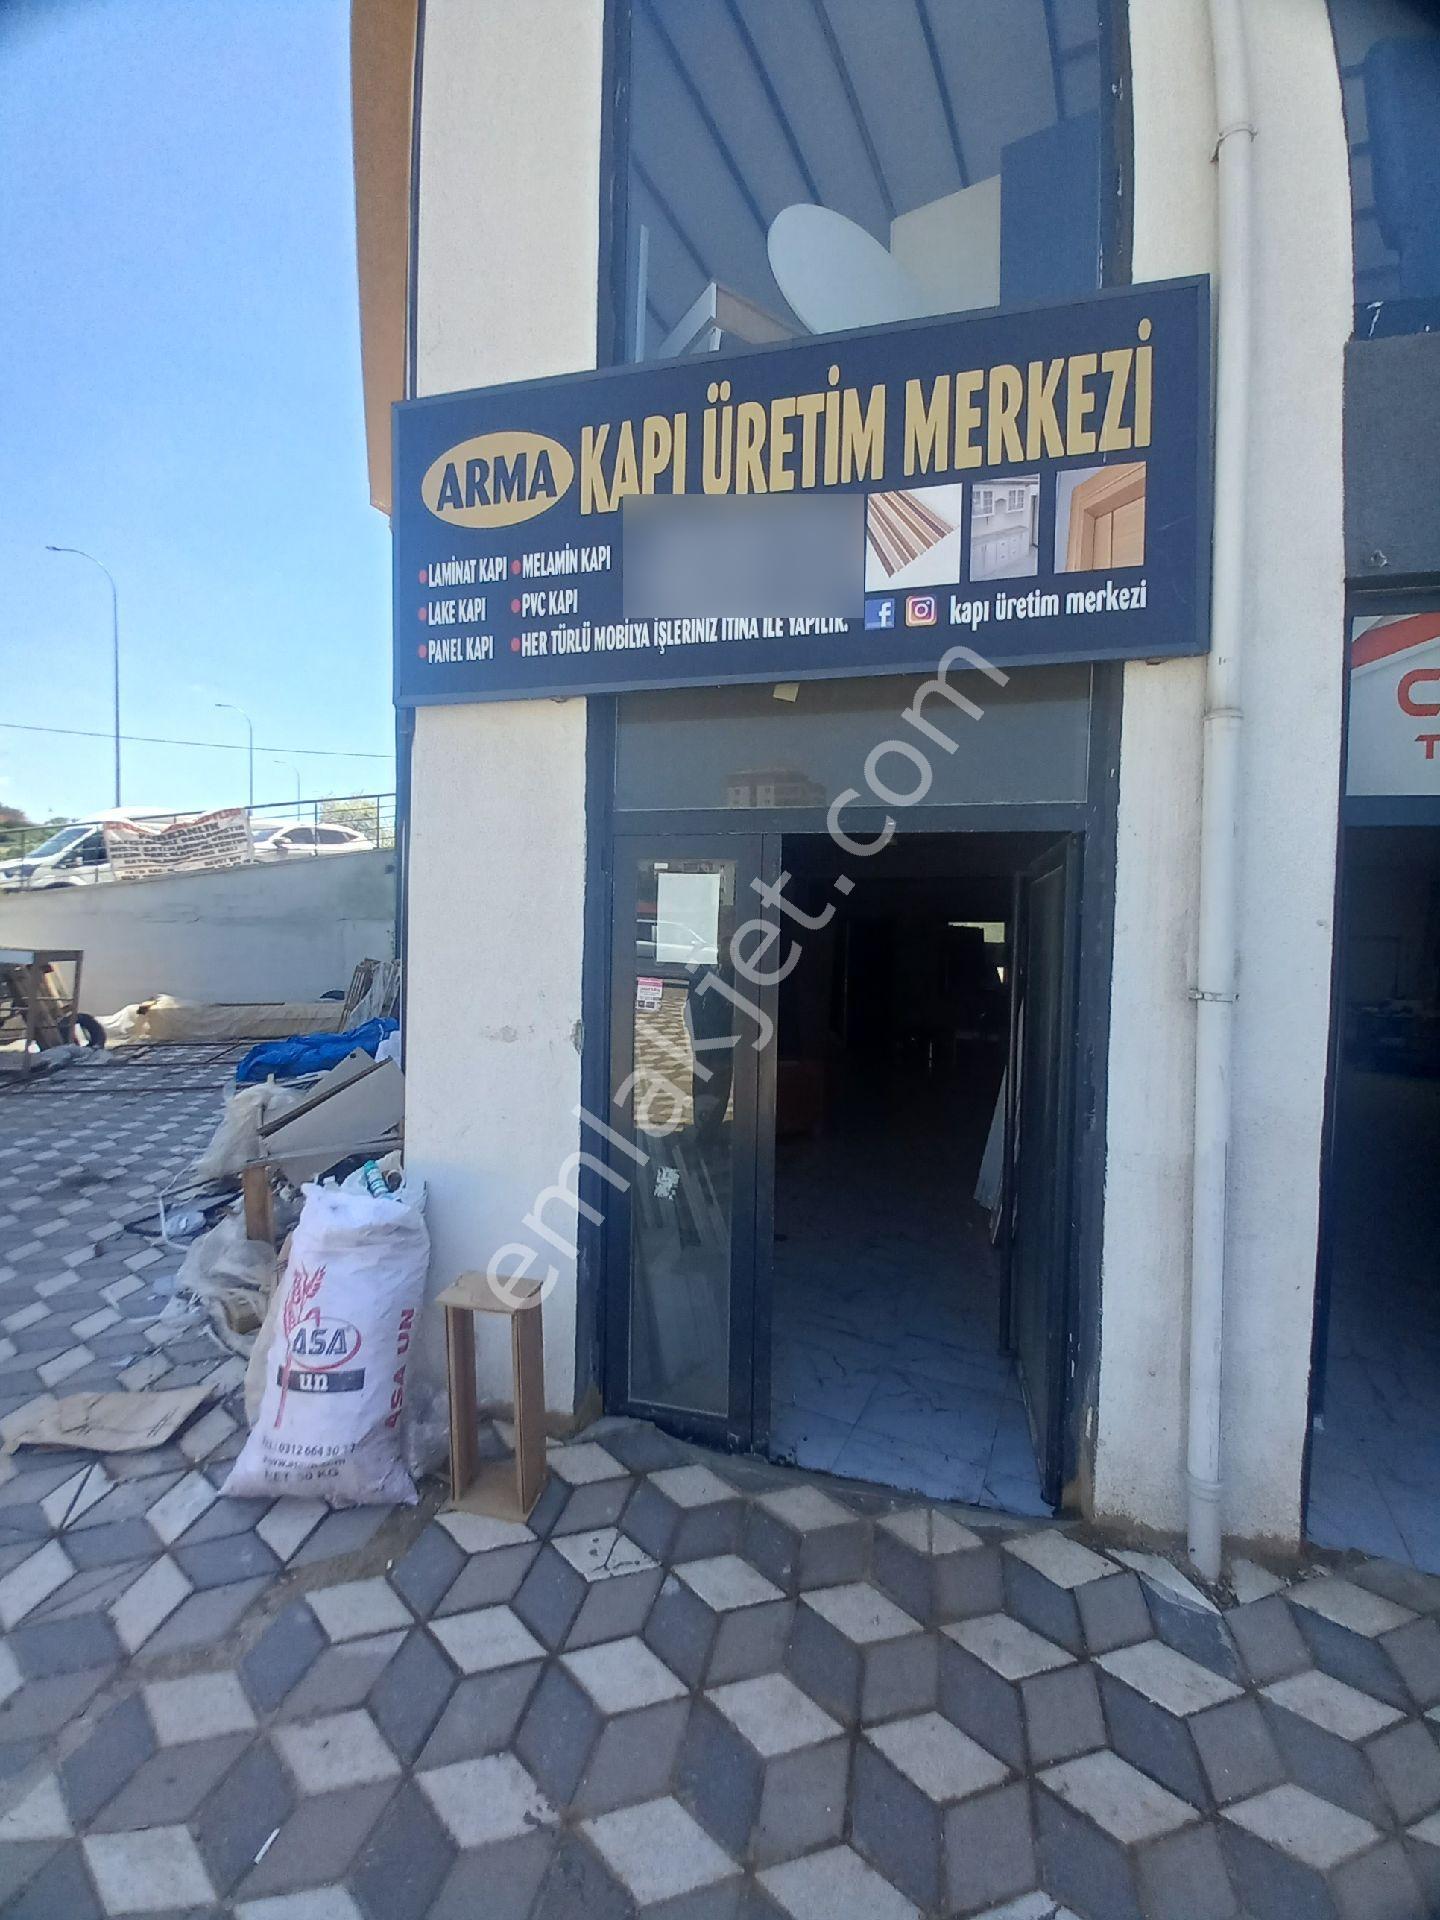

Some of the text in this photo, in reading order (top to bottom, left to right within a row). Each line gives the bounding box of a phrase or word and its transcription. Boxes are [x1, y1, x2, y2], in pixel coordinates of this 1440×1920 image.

[579, 318, 1153, 516] KAPI ÜRETİM MERKEZİ
[436, 450, 559, 512] ARMA
[428, 555, 508, 587] LAMİNAT KAPI
[522, 543, 611, 578] MELAMİN KAPI
[428, 597, 487, 626] LAKE KAPI
[521, 589, 578, 618] PVC KAPI
[949, 579, 1147, 631] kapı üretim merkezi
[428, 635, 494, 664] PANEL KAPI
[521, 630, 548, 657] HER
[551, 622, 591, 655] TÜRLÜ
[594, 618, 650, 652] MOBİLYA
[292, 1327, 348, 1355] ASA
[397, 1309, 414, 1355] UN
[299, 1373, 329, 1392] un
